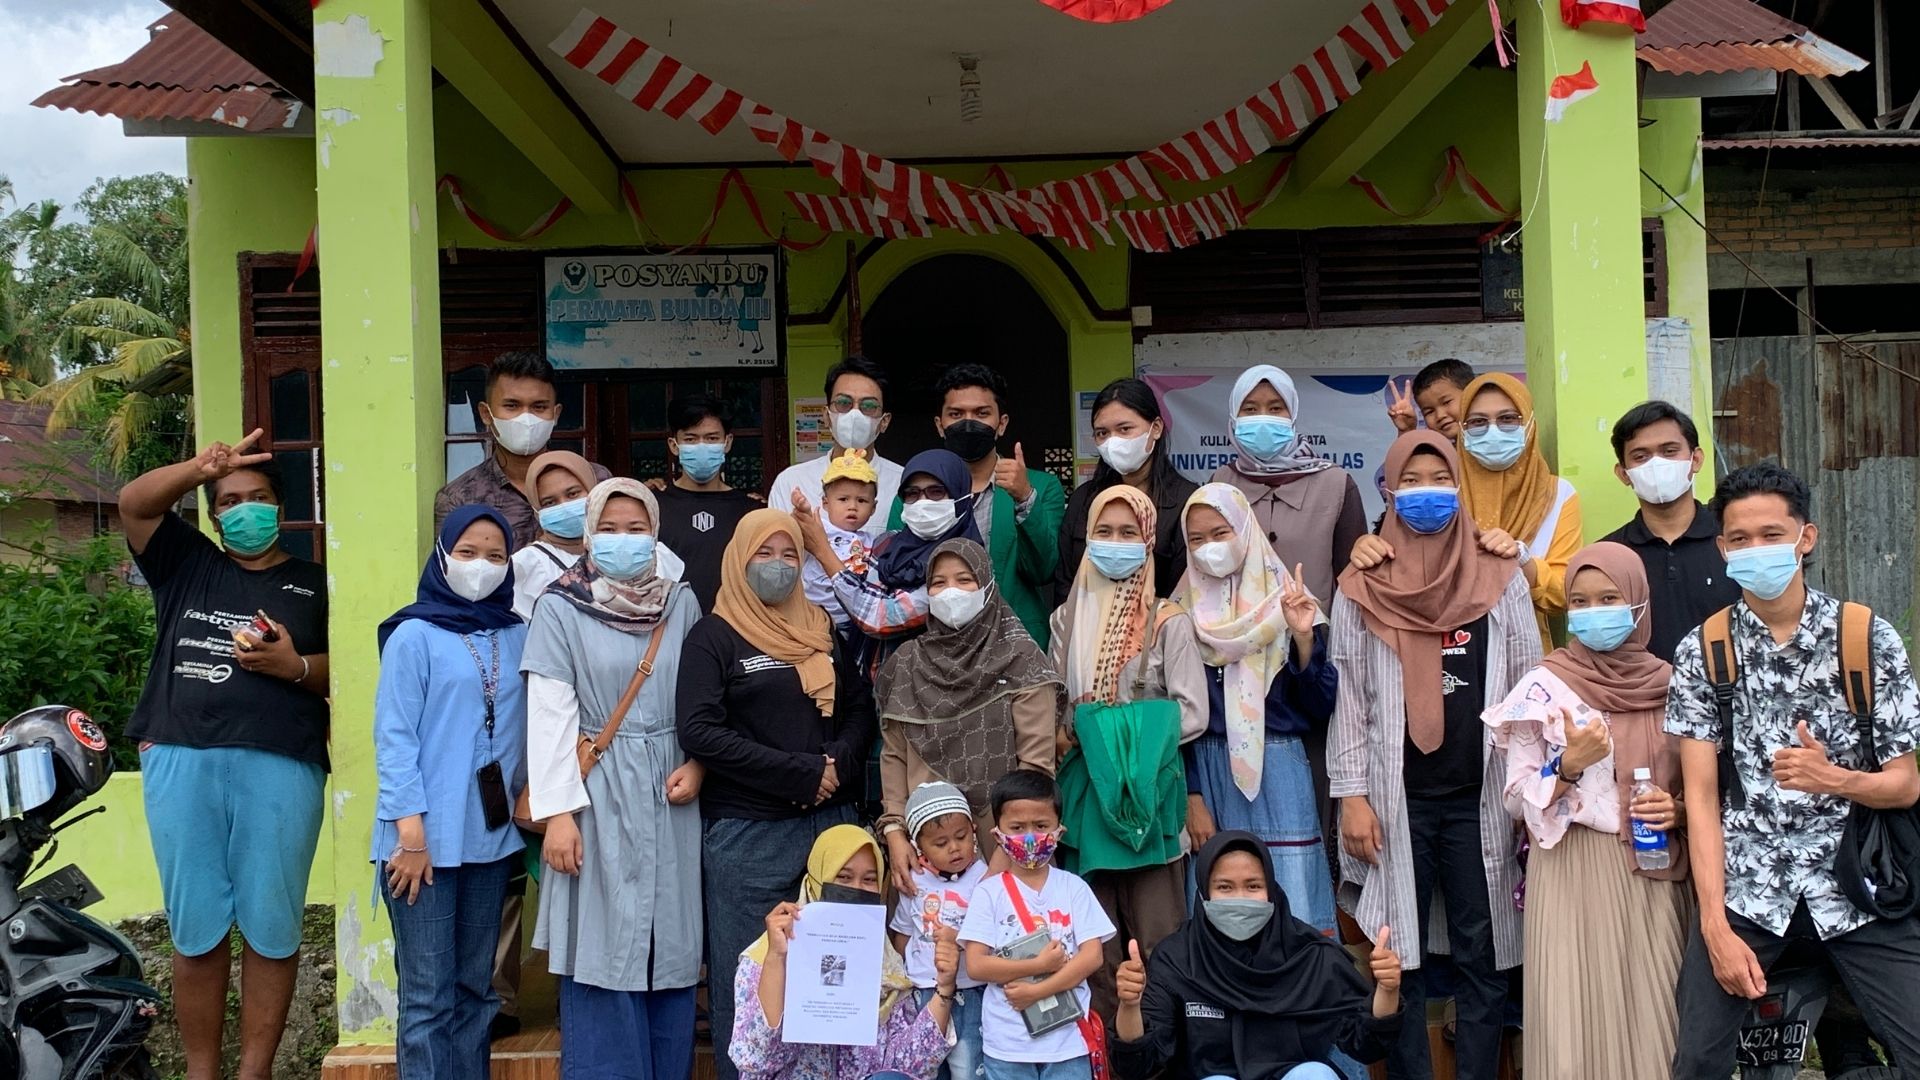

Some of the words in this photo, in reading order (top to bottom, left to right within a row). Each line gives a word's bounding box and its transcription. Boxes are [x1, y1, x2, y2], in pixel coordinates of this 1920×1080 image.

[593, 263, 760, 287] POSYANDU
[550, 300, 656, 323] PERMATA
[661, 298, 740, 322] BUNDA
[744, 297, 771, 320] III
[1200, 435, 1231, 447] KULI
[206, 636, 236, 646] PERTAMI
[1784, 1047, 1800, 1059] 22
